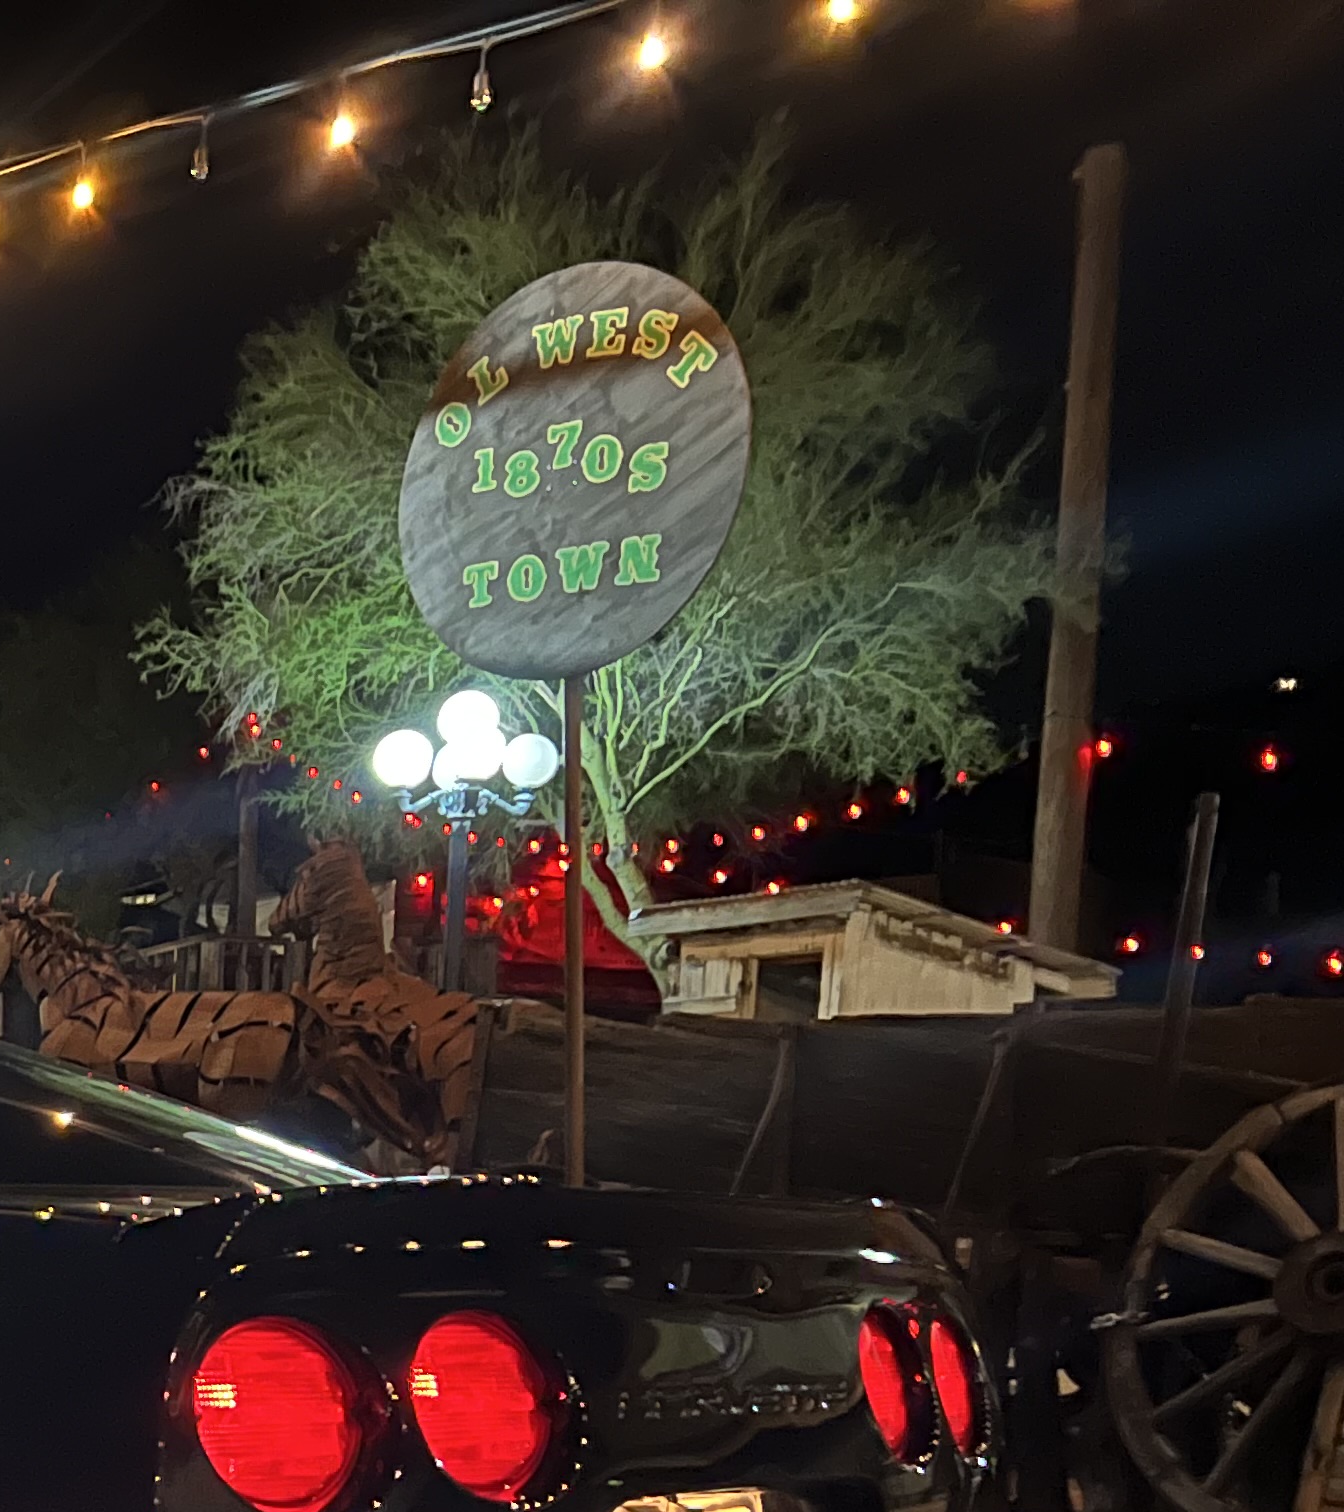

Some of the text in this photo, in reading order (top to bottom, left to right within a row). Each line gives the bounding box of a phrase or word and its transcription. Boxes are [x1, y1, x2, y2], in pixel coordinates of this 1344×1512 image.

[434, 306, 719, 448] OL WEST
[463, 533, 662, 608] TOWN
